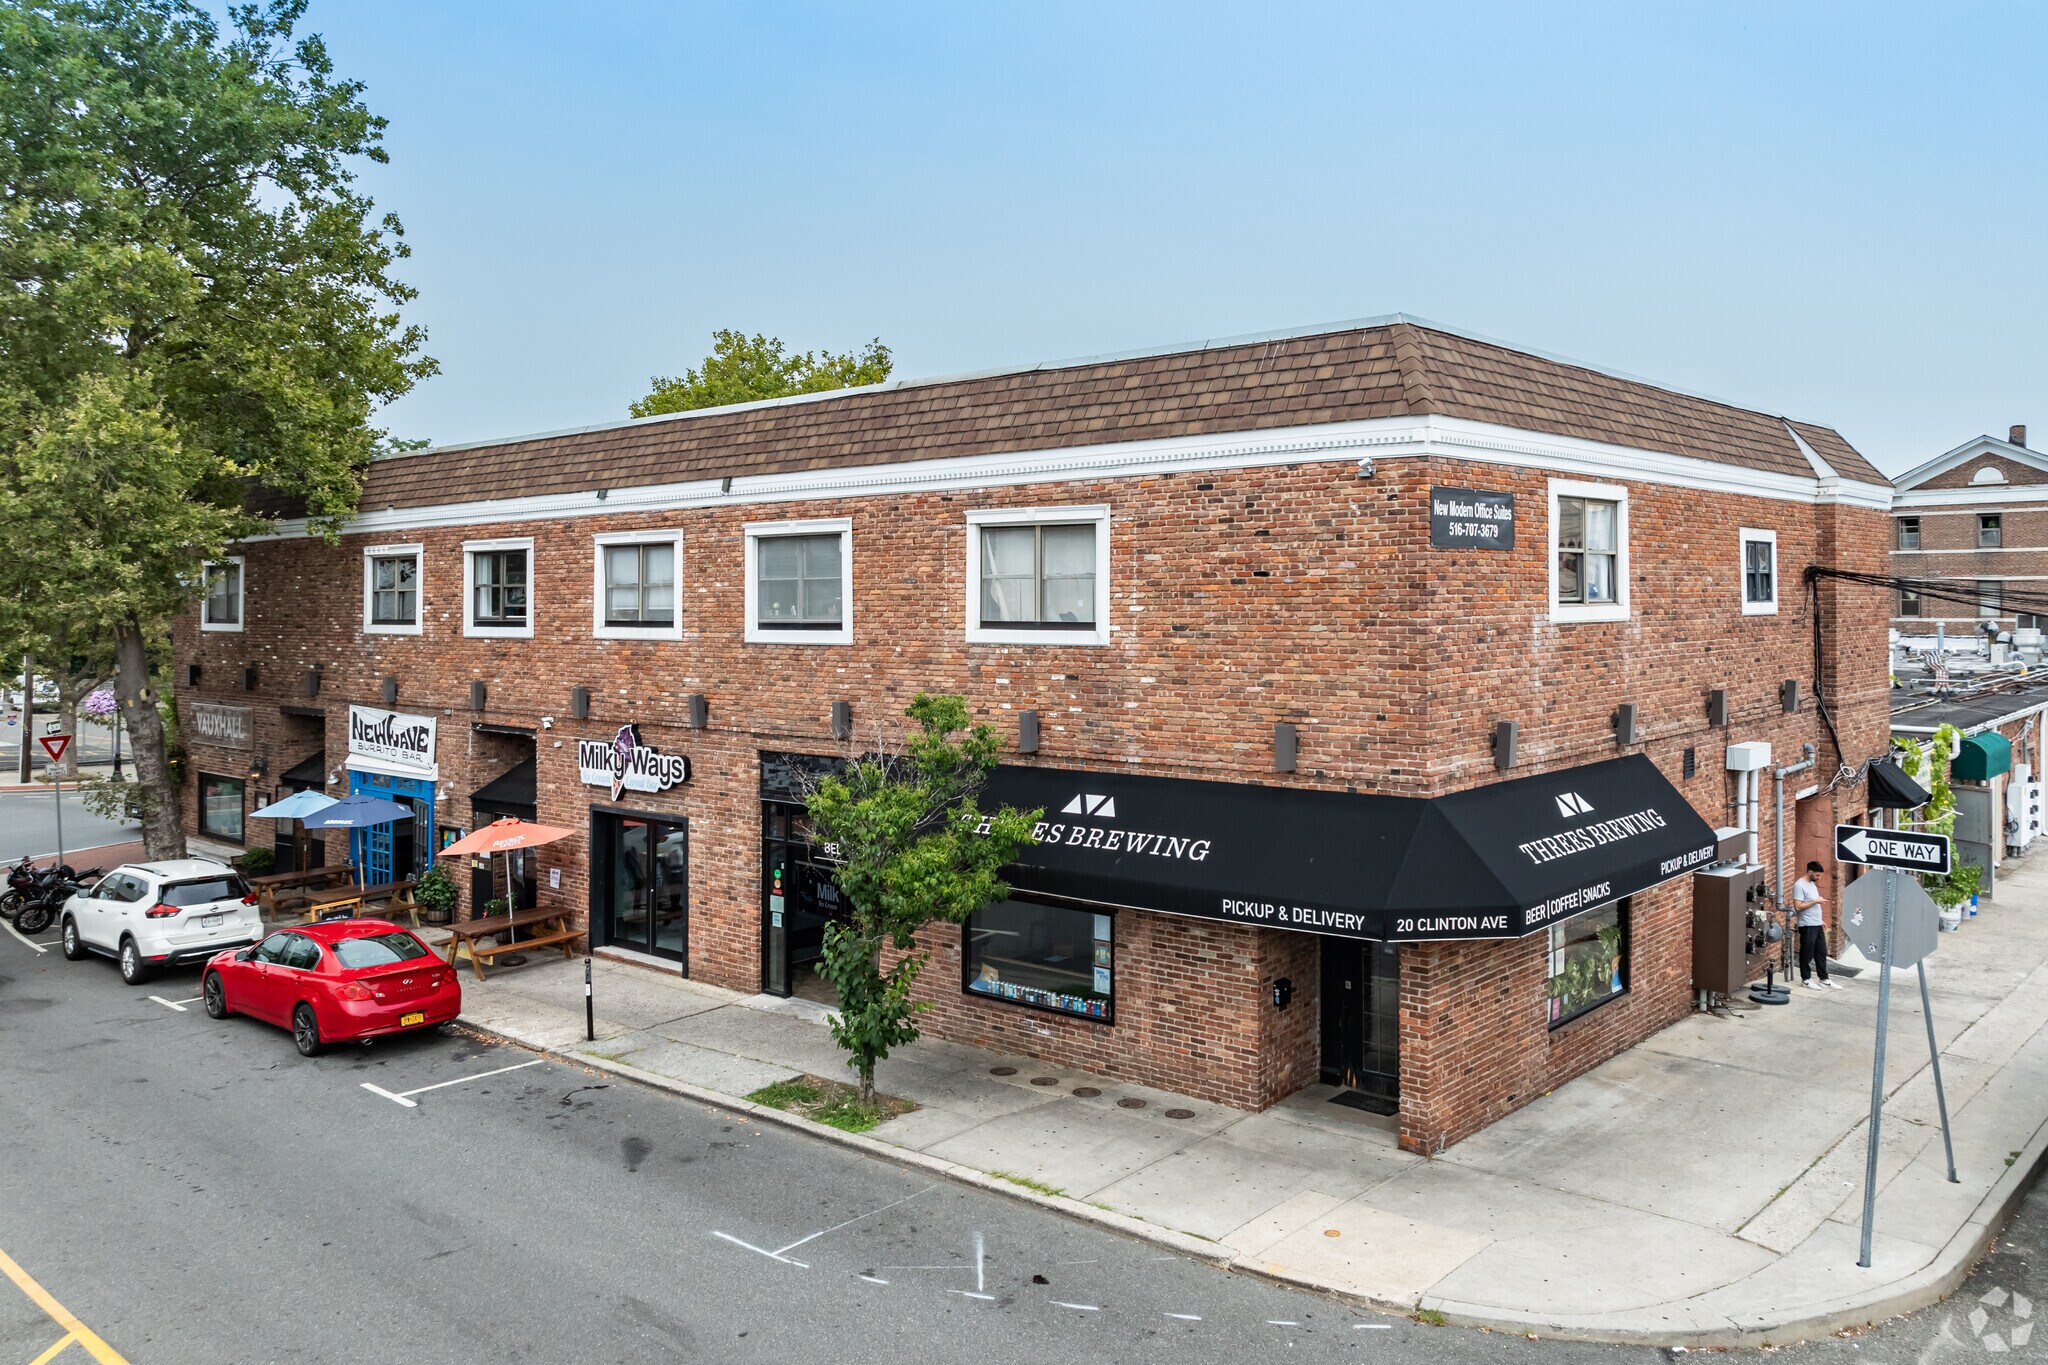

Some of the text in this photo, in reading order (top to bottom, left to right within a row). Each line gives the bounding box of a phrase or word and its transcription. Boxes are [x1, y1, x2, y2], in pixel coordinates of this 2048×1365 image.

[1434, 499, 1512, 520] New Modern Office Suites
[1449, 522, 1499, 538] 516-707-3679
[196, 713, 245, 738] VAUXHALL
[358, 742, 423, 762] BURRITO BAR
[581, 743, 683, 786] Milky Ways
[959, 813, 1211, 861] HES BREWING
[1519, 808, 1667, 864] THREES BREWING
[1661, 860, 1682, 876] PICKUP
[1688, 846, 1714, 865] DELIVERY
[1868, 840, 1935, 860] ONE WAY
[1222, 899, 1365, 931] PICKUP & DELIVERY
[1397, 915, 1508, 932] 20 CLINTON AVE
